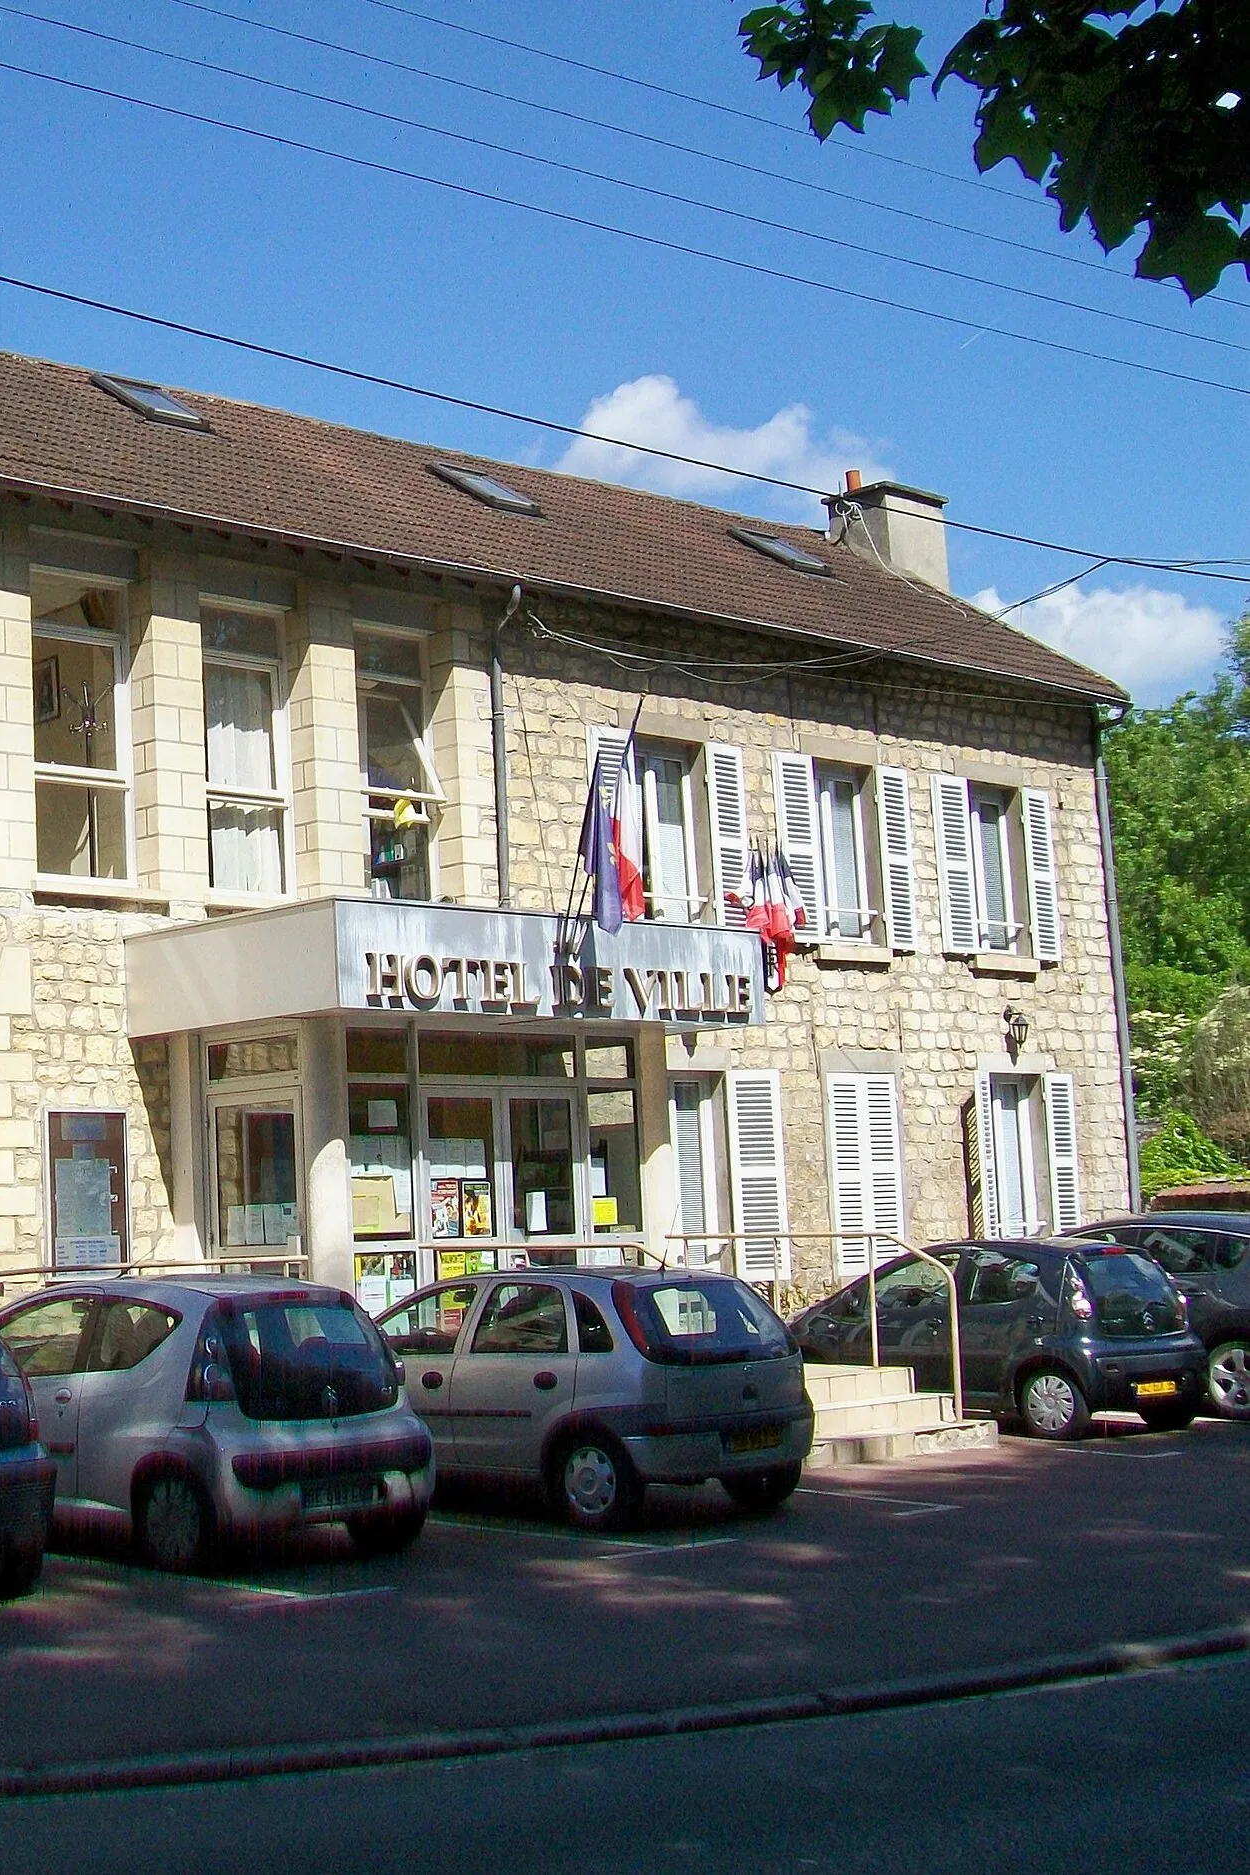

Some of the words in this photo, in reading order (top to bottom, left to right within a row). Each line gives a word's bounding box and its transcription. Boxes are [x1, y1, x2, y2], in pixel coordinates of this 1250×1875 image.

[364, 952, 543, 1007] HOTEL
[548, 964, 615, 1010] DE
[622, 967, 753, 1017] VILLE
